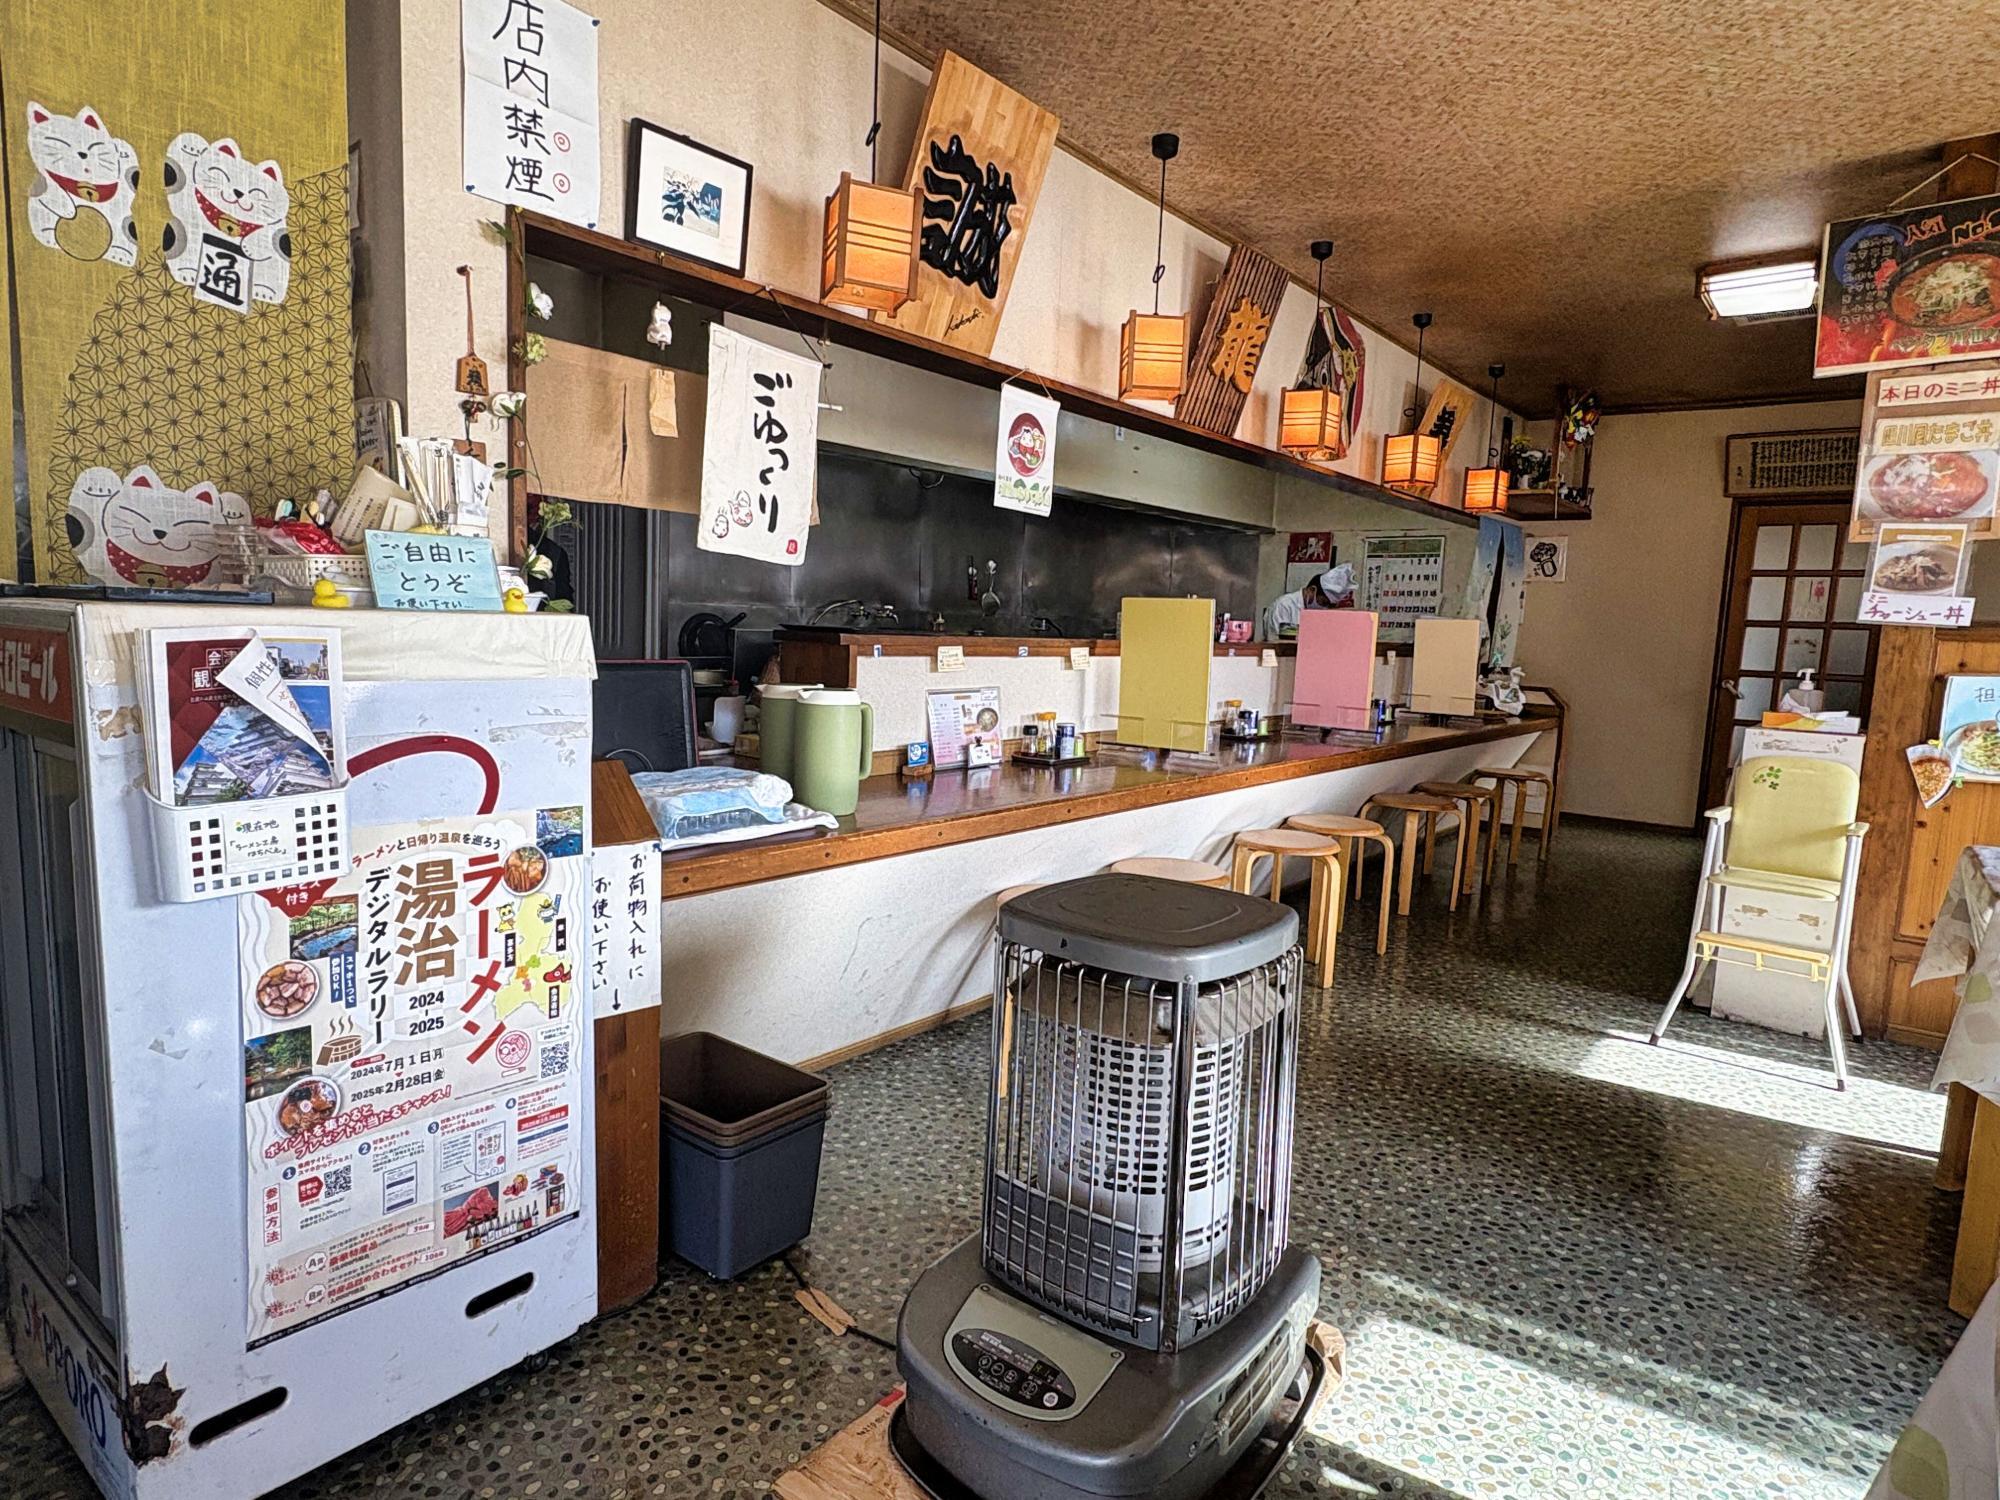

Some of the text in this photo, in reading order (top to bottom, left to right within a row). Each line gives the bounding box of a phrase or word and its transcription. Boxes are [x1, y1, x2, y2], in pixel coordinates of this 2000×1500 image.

[492, 0, 555, 202] 店内禁煙
[199, 251, 244, 306] 通
[1881, 376, 2000, 403] 本日のミニ丼
[753, 372, 793, 534] ごゆっくり
[380, 542, 476, 563] ご自由に
[1864, 604, 1965, 624] チャーシュー丼
[1868, 594, 1888, 604] ミニ
[0, 639, 58, 704] ロビール
[242, 820, 279, 834] 現在地
[352, 832, 501, 868] ラーメンと日帰り温泉を巡ろう
[285, 892, 309, 906] 付き
[395, 858, 459, 986] 湯治
[627, 853, 648, 980] お荷物入れに
[365, 866, 393, 1045] デジタルラリー
[460, 853, 507, 1065] ラーメン
[592, 877, 613, 990] お使い下さい
[409, 991, 444, 1010] 2024
[409, 1016, 444, 1036] 2025
[265, 1103, 374, 1159] ポイントを集めると
[265, 1187, 282, 1245] 参加方法
